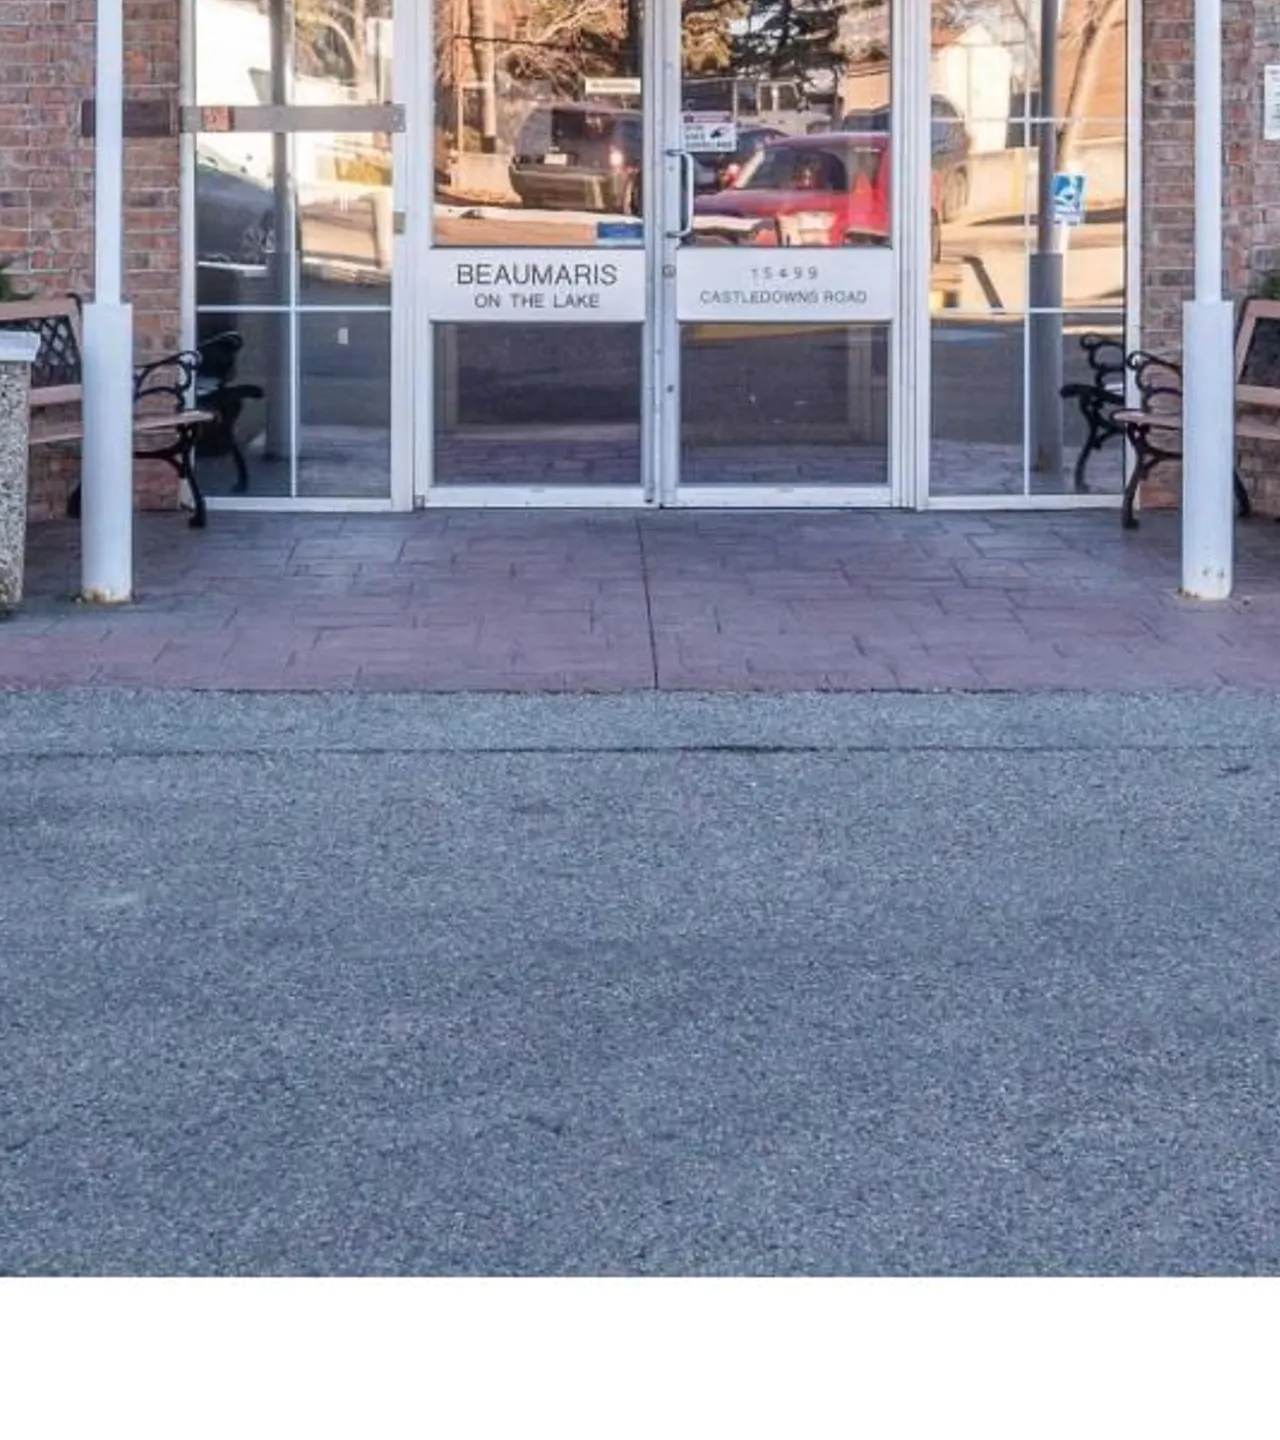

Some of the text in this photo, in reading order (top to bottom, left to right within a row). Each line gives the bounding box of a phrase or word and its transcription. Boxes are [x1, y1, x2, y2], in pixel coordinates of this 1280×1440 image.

[456, 263, 618, 285] BEAUMARIS
[750, 266, 819, 279] 15499
[473, 292, 601, 309] ON THE LAKE
[699, 289, 868, 304] CASTLEDOWNS ROAD
